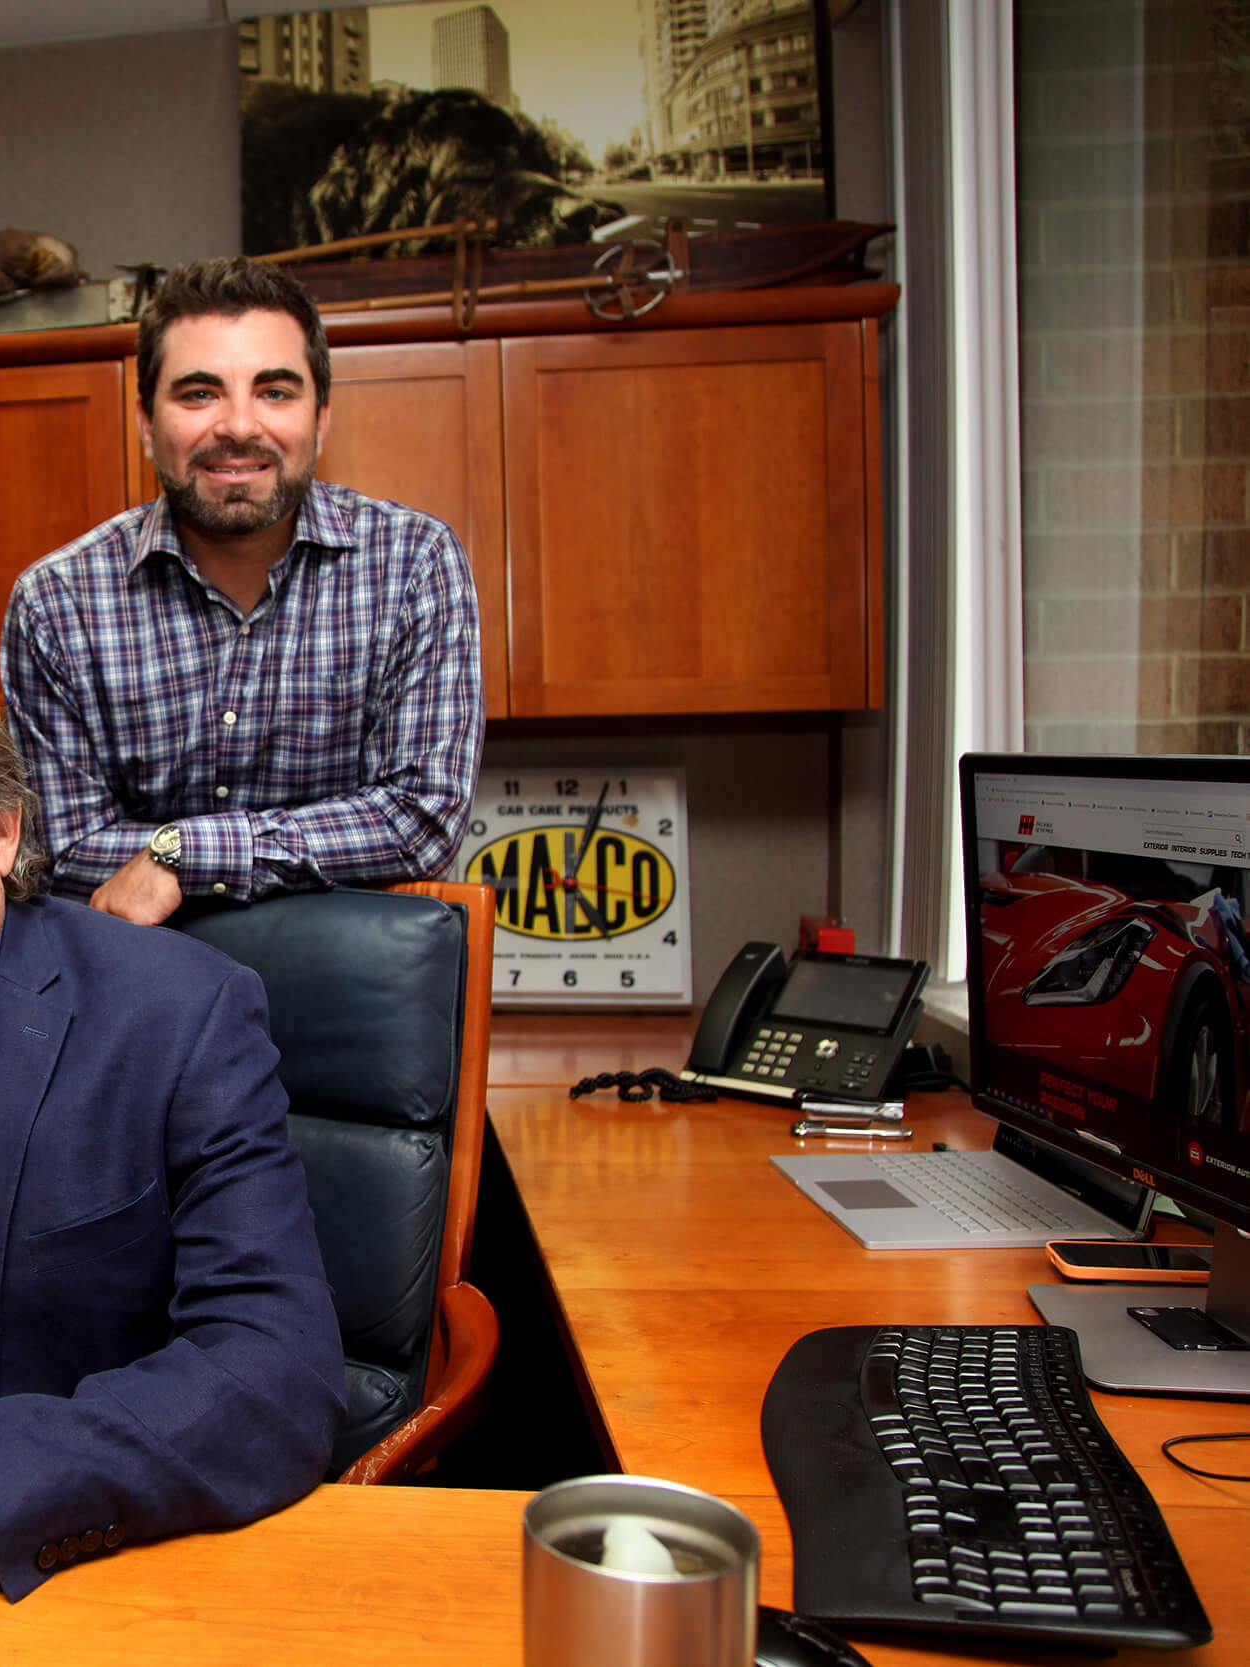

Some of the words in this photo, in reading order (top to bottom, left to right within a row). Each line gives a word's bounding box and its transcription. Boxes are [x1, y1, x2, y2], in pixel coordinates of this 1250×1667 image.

[504, 780, 520, 796] 11
[555, 780, 579, 796] 12
[618, 780, 628, 796] 1
[497, 805, 524, 816] CAR
[529, 805, 563, 816] CARE
[658, 819, 673, 836] 2
[1143, 841, 1169, 851] EXTERIOR
[1171, 845, 1198, 854] INTERIOR
[1199, 848, 1228, 858] SUPPLIES
[1230, 850, 1247, 859] TECH
[481, 833, 659, 934] MALCO
[662, 931, 678, 946] 4
[508, 970, 522, 986] 7
[563, 970, 578, 987] 6
[620, 970, 636, 988] 5
[1038, 1072, 1086, 1098] PERFECT
[1086, 1088, 1118, 1113] YOUR
[1038, 1090, 1086, 1120] PASSION
[1205, 1154, 1236, 1174] EXTERIOR
[1133, 1167, 1156, 1186] DELL
